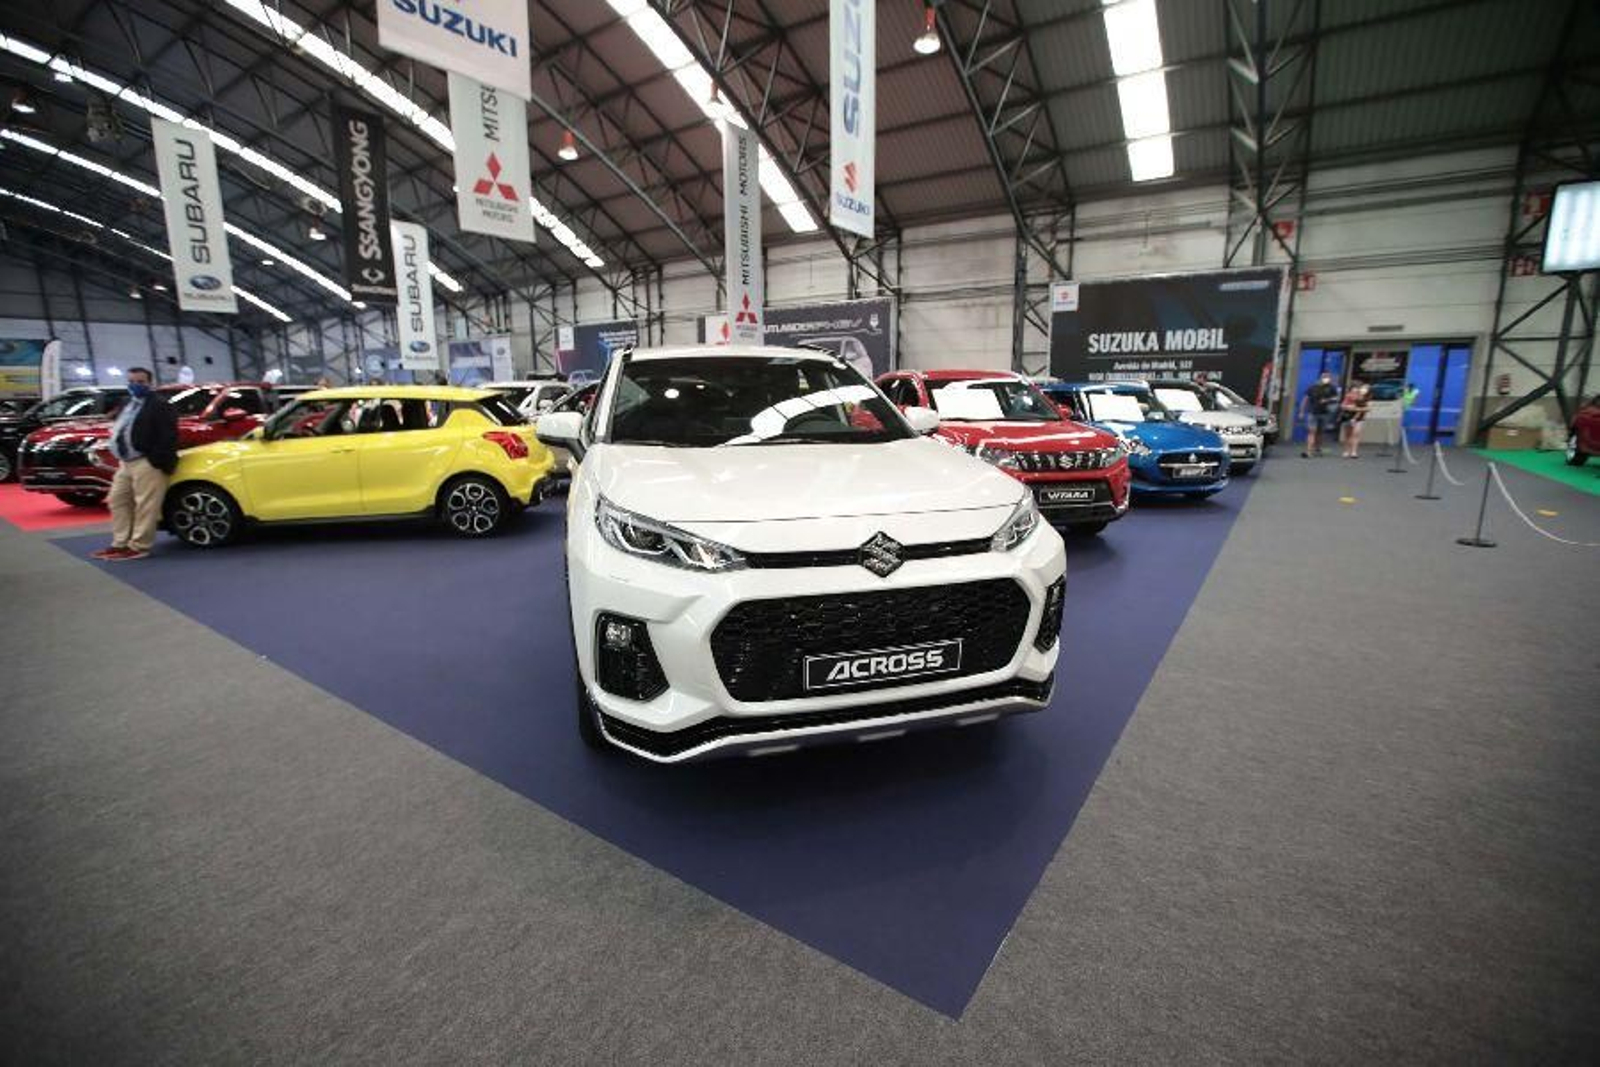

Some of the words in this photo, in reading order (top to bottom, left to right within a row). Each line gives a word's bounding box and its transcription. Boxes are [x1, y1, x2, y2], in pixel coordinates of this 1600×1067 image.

[843, 0, 861, 138] SUZ
[174, 138, 211, 264] SUBARU
[349, 119, 382, 261] SSANGYONG
[738, 136, 748, 197] MOTORS
[402, 234, 424, 333] SUBARU
[1088, 331, 1159, 354] SUZUKA
[826, 649, 944, 681] ACROSS
